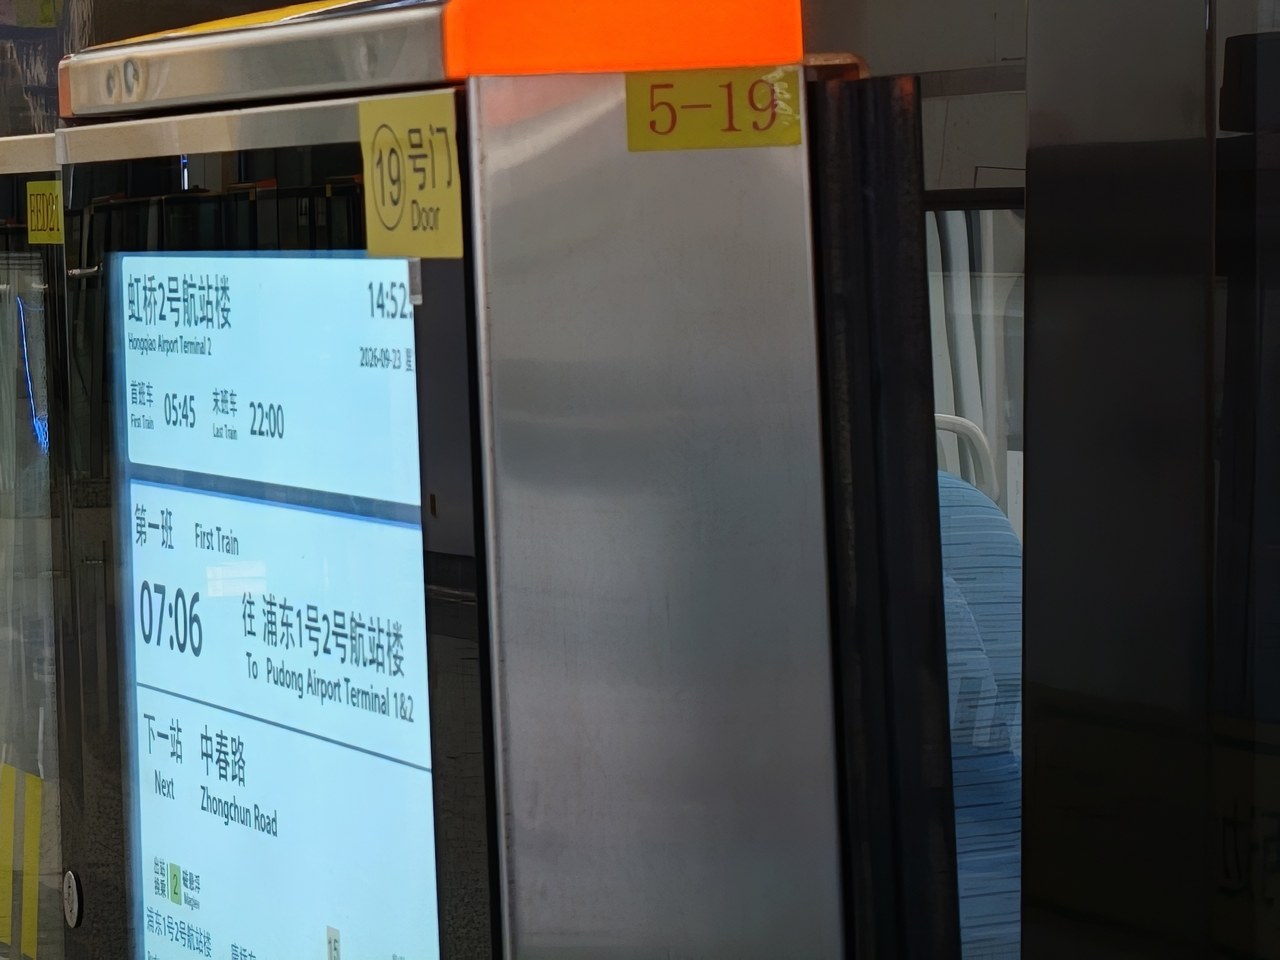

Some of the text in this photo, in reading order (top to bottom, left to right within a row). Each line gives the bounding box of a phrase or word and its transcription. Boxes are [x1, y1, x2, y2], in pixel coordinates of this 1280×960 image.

[649, 79, 777, 136] 5-19
[411, 199, 440, 231] Door
[127, 274, 231, 329] 虹桥2号航站楼
[128, 332, 212, 357] Hongqiao Airport Terminal 2
[130, 380, 154, 408] 首班车
[164, 392, 196, 428] 05:45
[212, 387, 237, 417] 末班车
[249, 401, 285, 439] 22:00
[135, 504, 174, 550] 第一班
[195, 523, 239, 555] First Train
[140, 580, 202, 657] 07:06
[242, 592, 405, 677] 往 浦东1号2号航站楼
[246, 652, 414, 723] To Pudong Airport Terminal 1&2
[143, 713, 183, 765] 下一站
[200, 724, 246, 788] 中春路
[154, 769, 175, 801] Next
[200, 785, 278, 838] Zhongchun Road
[172, 873, 179, 896] 2
